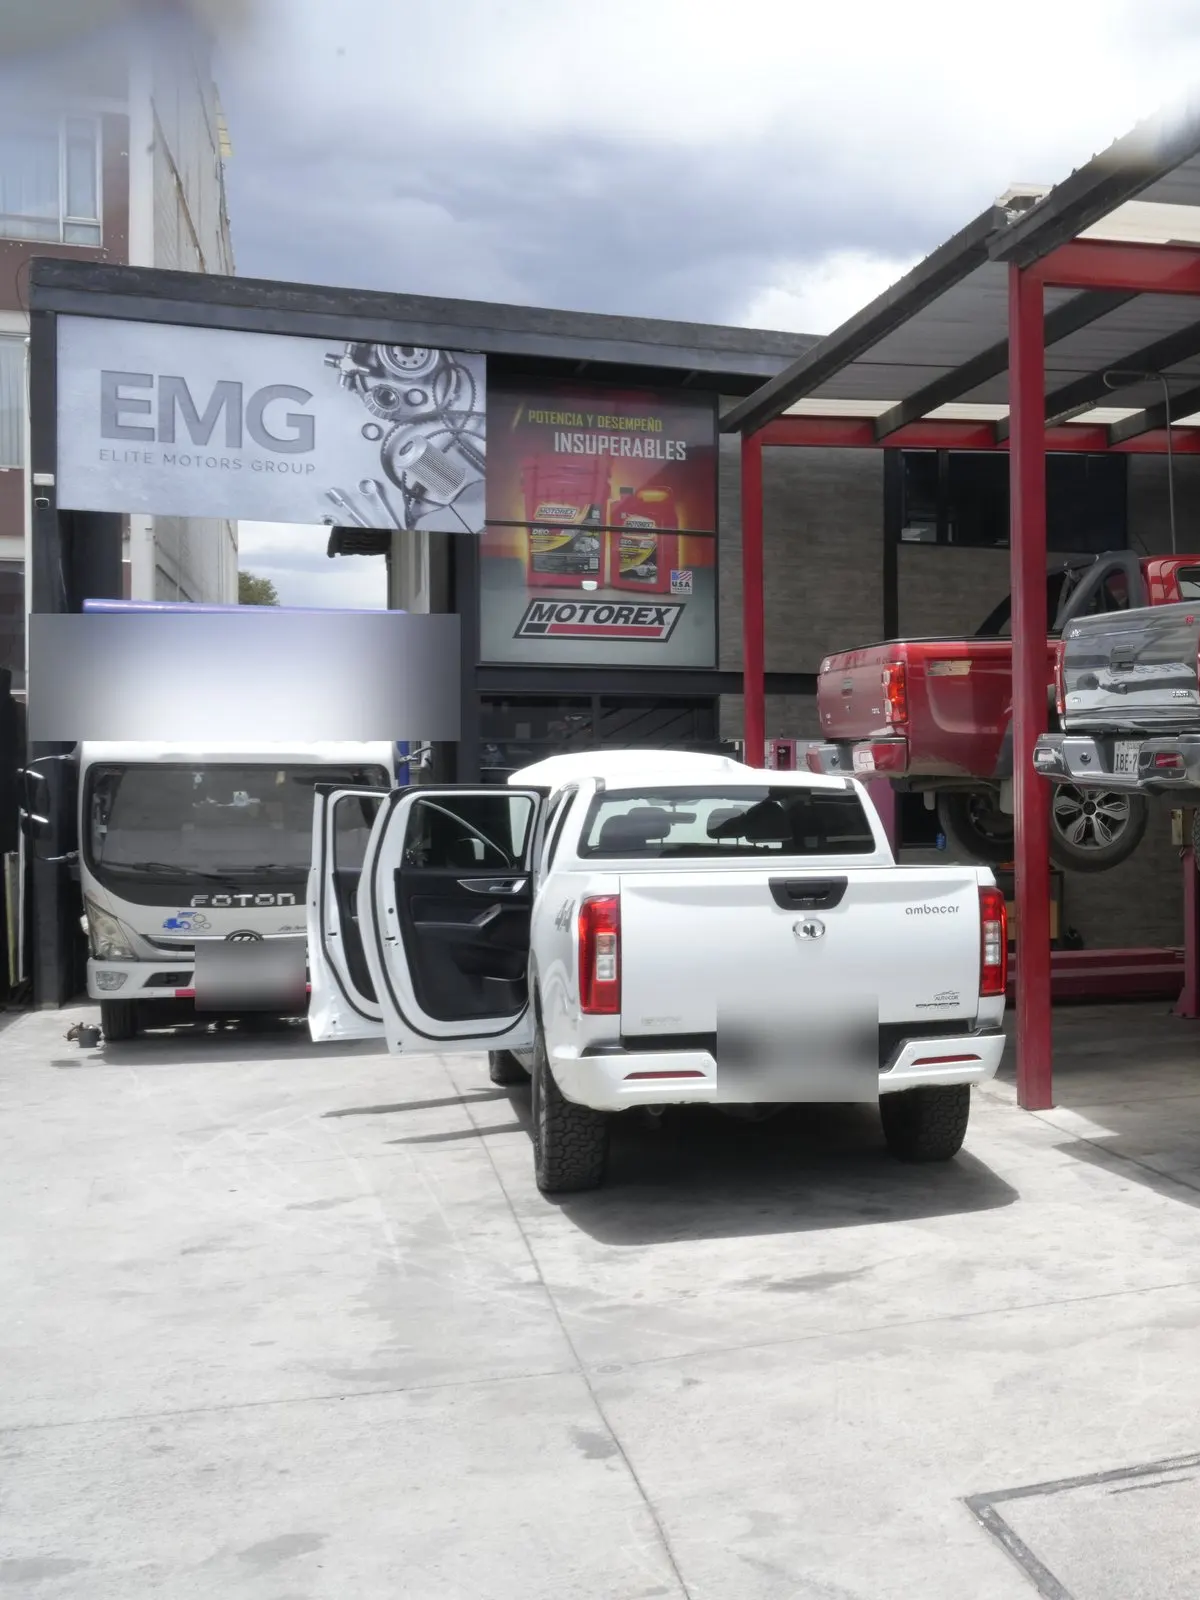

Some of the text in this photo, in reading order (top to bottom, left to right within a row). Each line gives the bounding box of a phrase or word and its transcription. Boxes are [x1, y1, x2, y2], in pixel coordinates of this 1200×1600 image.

[101, 370, 315, 454] EMG
[528, 409, 662, 432] POTENCIA Y DESEMPEÑO
[554, 431, 687, 461] INSUPERABLES
[99, 449, 316, 475] ELITE MOTORS GROUP
[529, 603, 672, 626] MOTOREX
[191, 893, 296, 907] FOTON
[905, 904, 960, 915] ambacar
